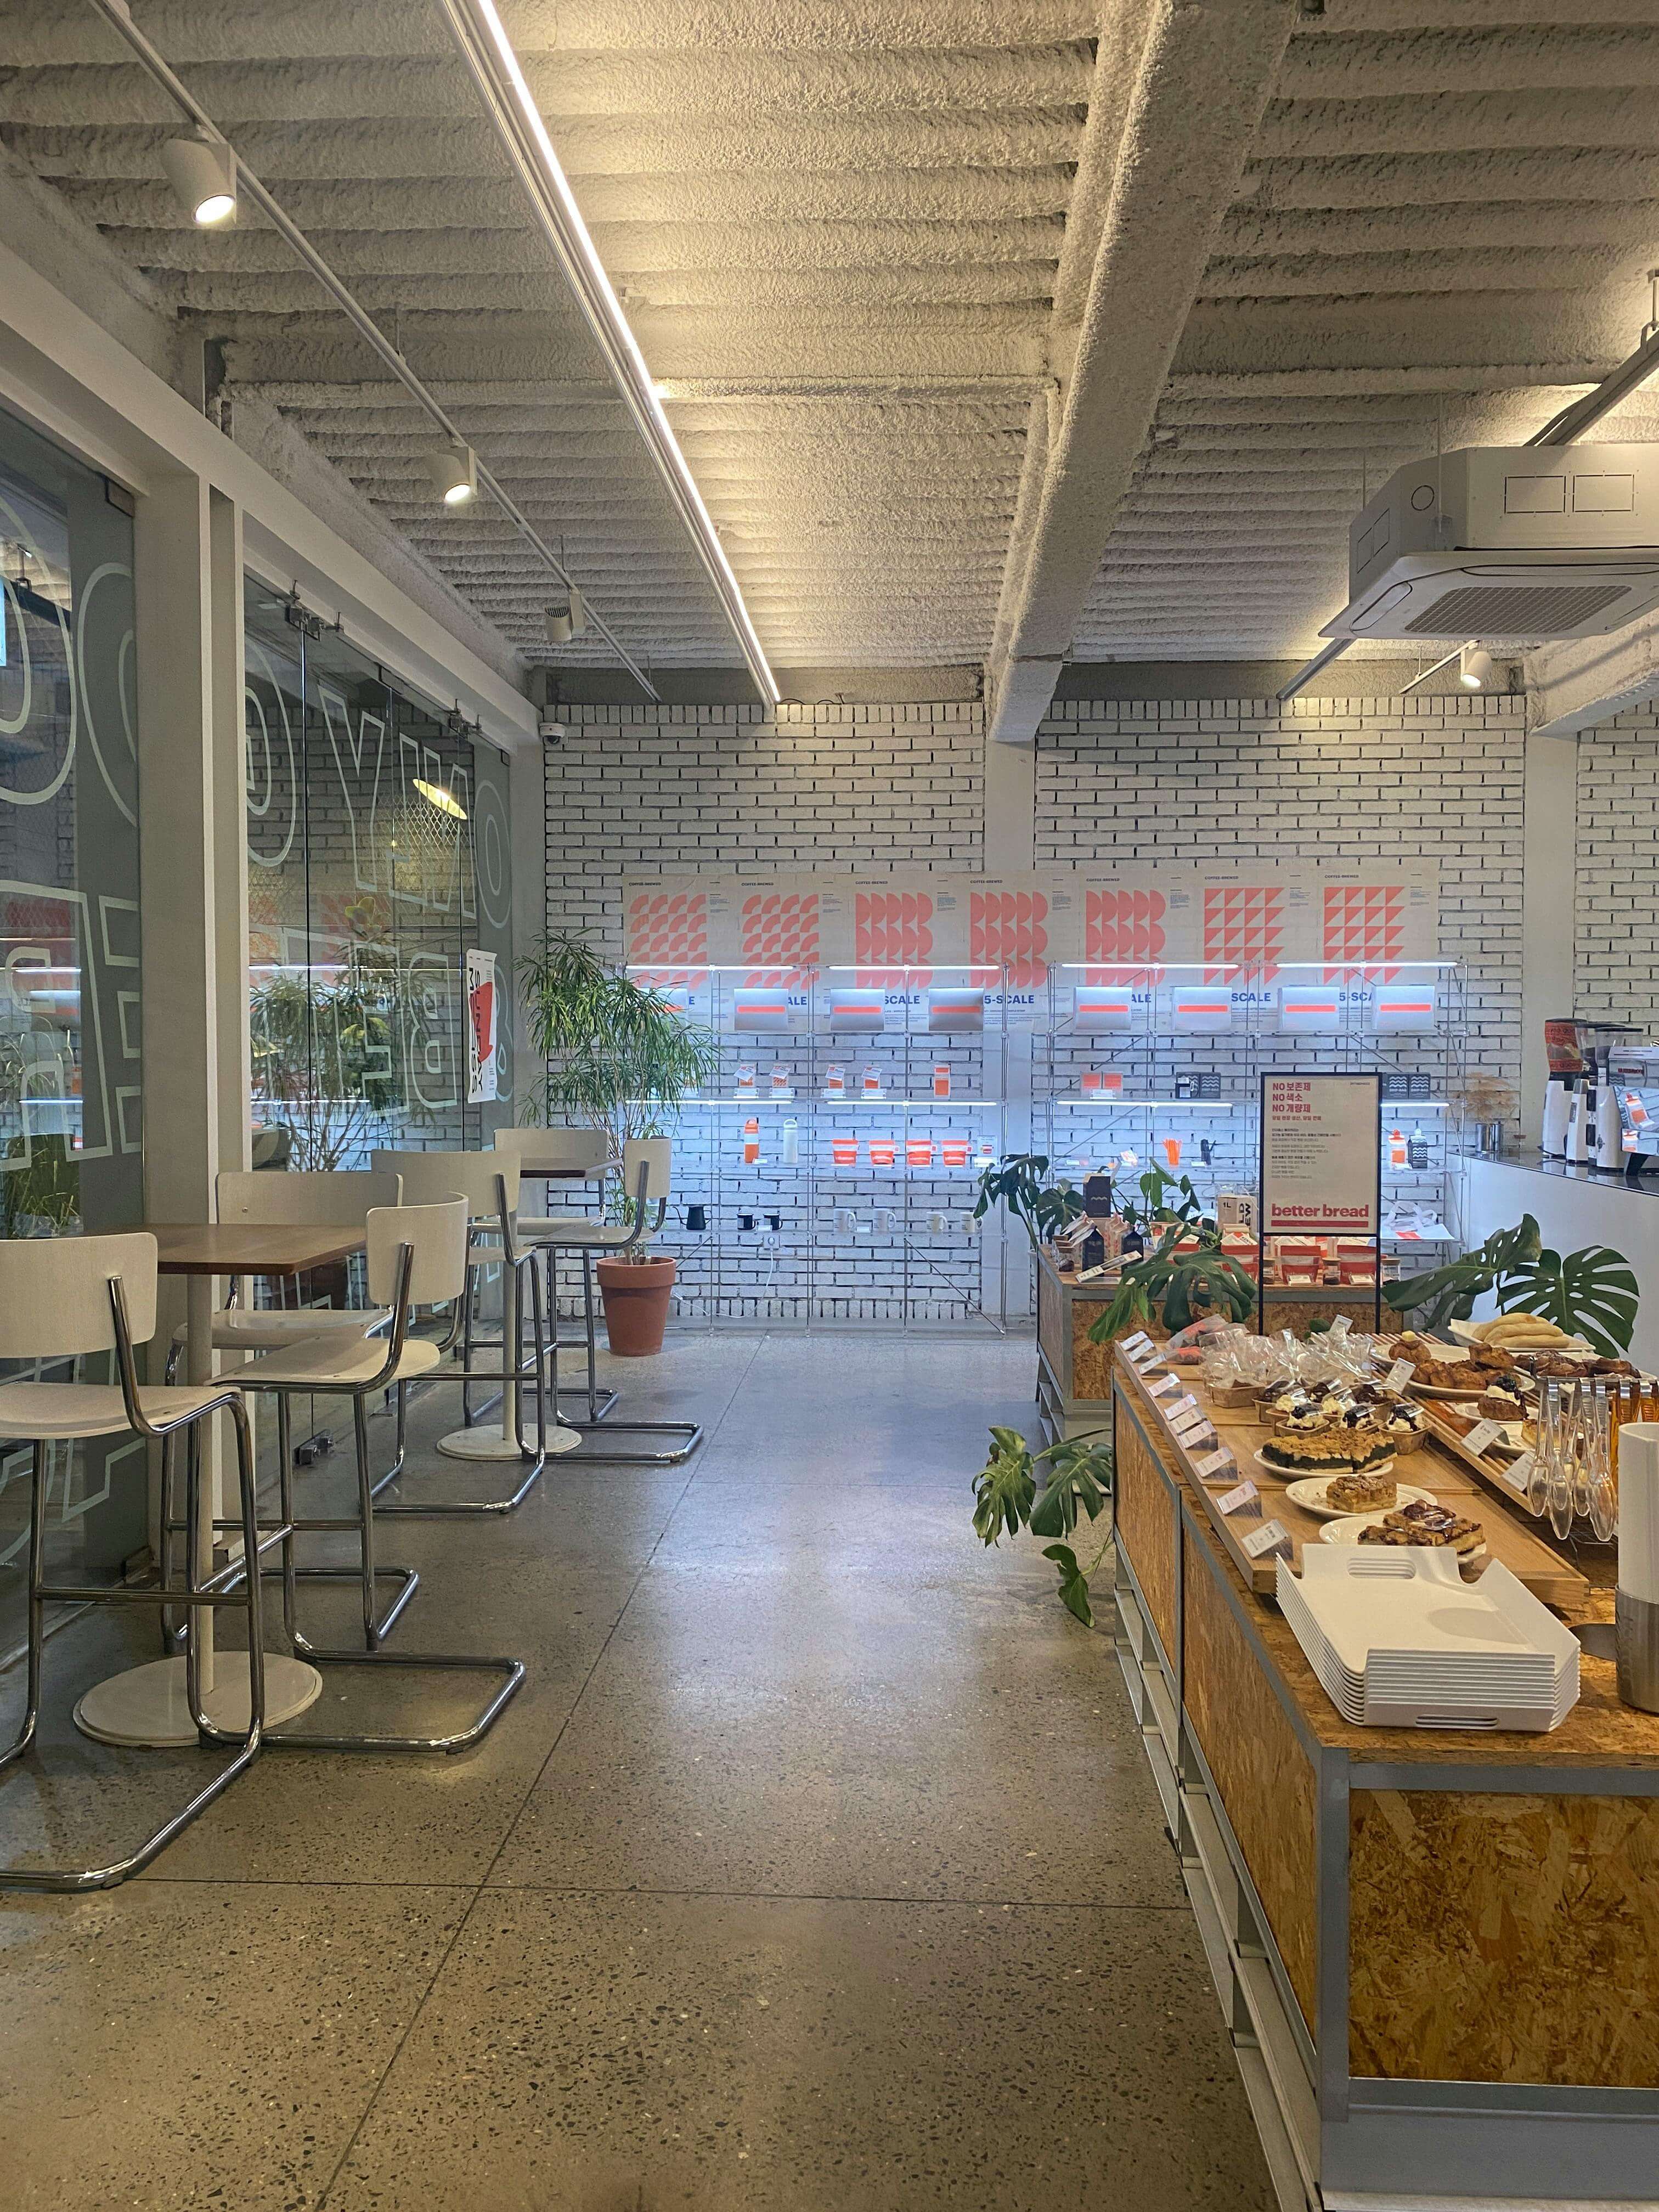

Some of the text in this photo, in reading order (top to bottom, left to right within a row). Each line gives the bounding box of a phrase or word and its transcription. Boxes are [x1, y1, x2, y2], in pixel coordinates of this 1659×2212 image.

[984, 995, 1035, 1005] 5-SCALE
[1231, 992, 1271, 1002] SCALE
[1272, 1082, 1311, 1091] NO 보존제
[1272, 1093, 1303, 1102] NO 색소
[1286, 1104, 1311, 1113] 개량제
[1271, 1203, 1369, 1217] better bread
